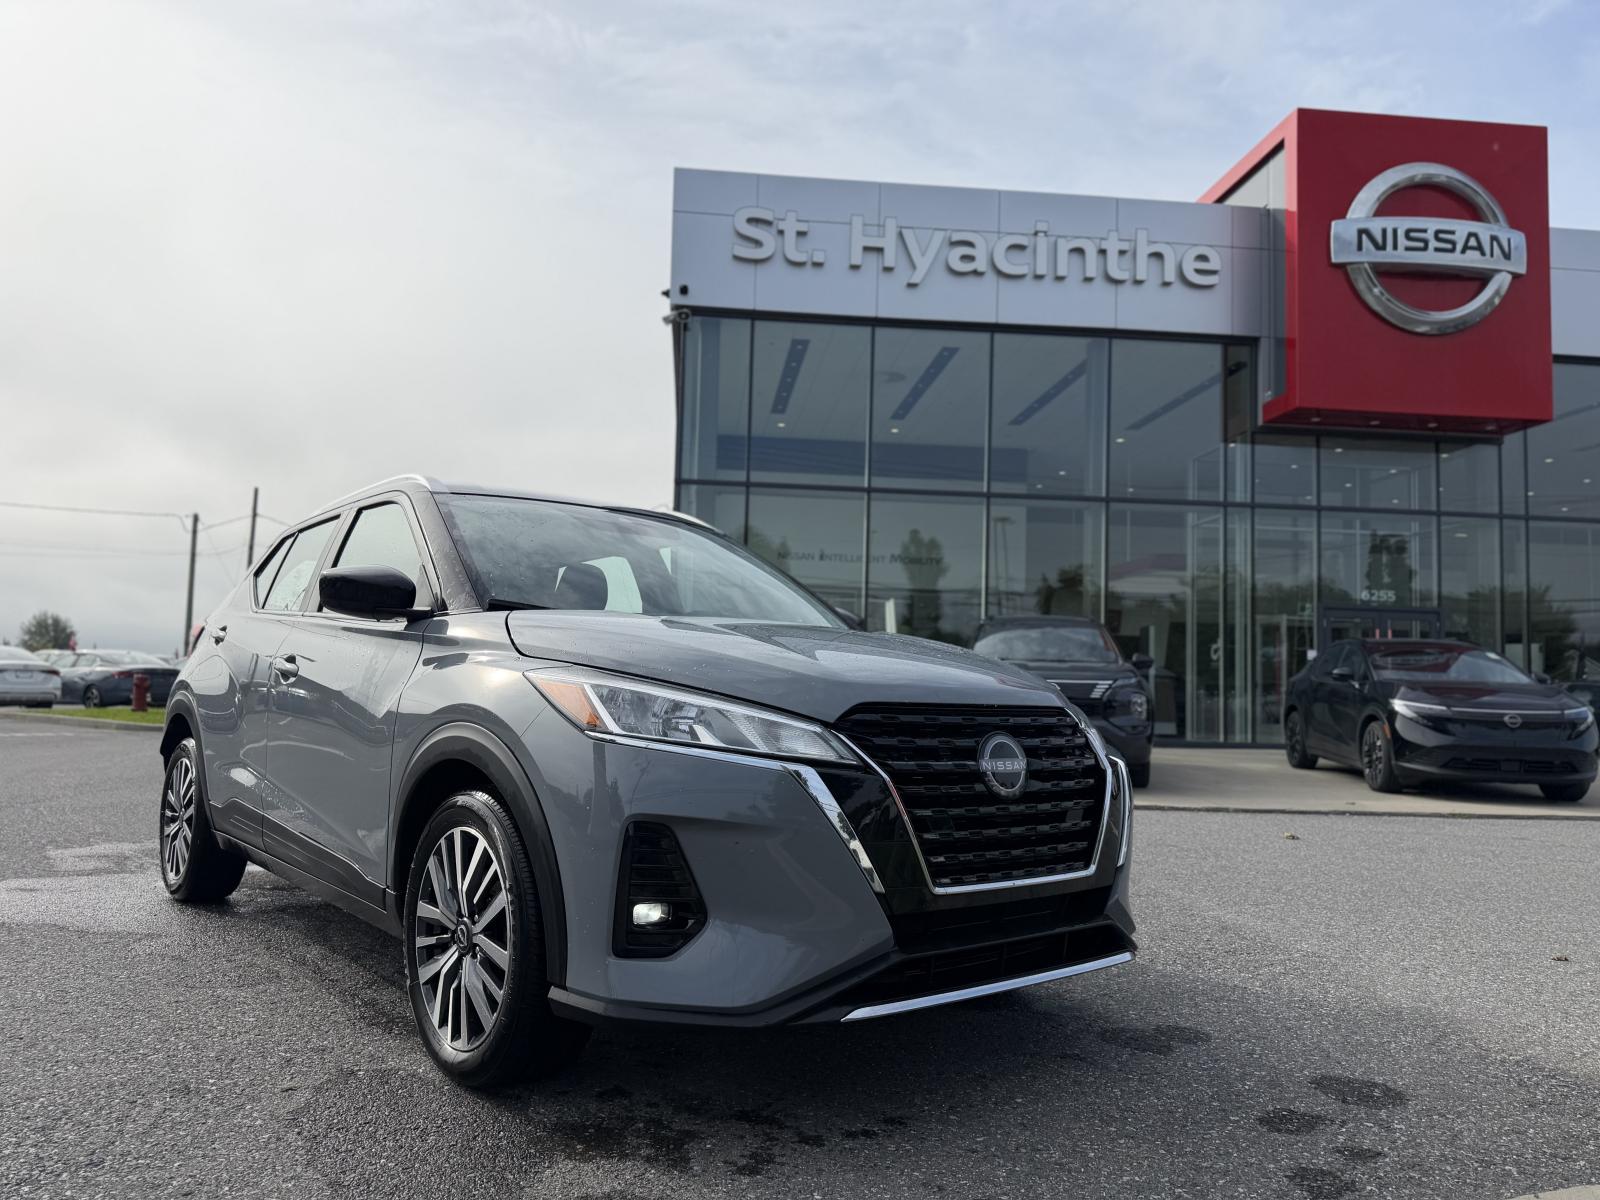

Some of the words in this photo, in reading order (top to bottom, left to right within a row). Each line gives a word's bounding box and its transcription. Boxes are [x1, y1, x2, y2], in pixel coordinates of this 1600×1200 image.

[732, 206, 826, 267] St.
[848, 214, 1223, 288] Hyacinthe
[1356, 227, 1512, 261] NISSAN
[1361, 589, 1396, 602] 6255
[982, 761, 1026, 770] NISSAN
